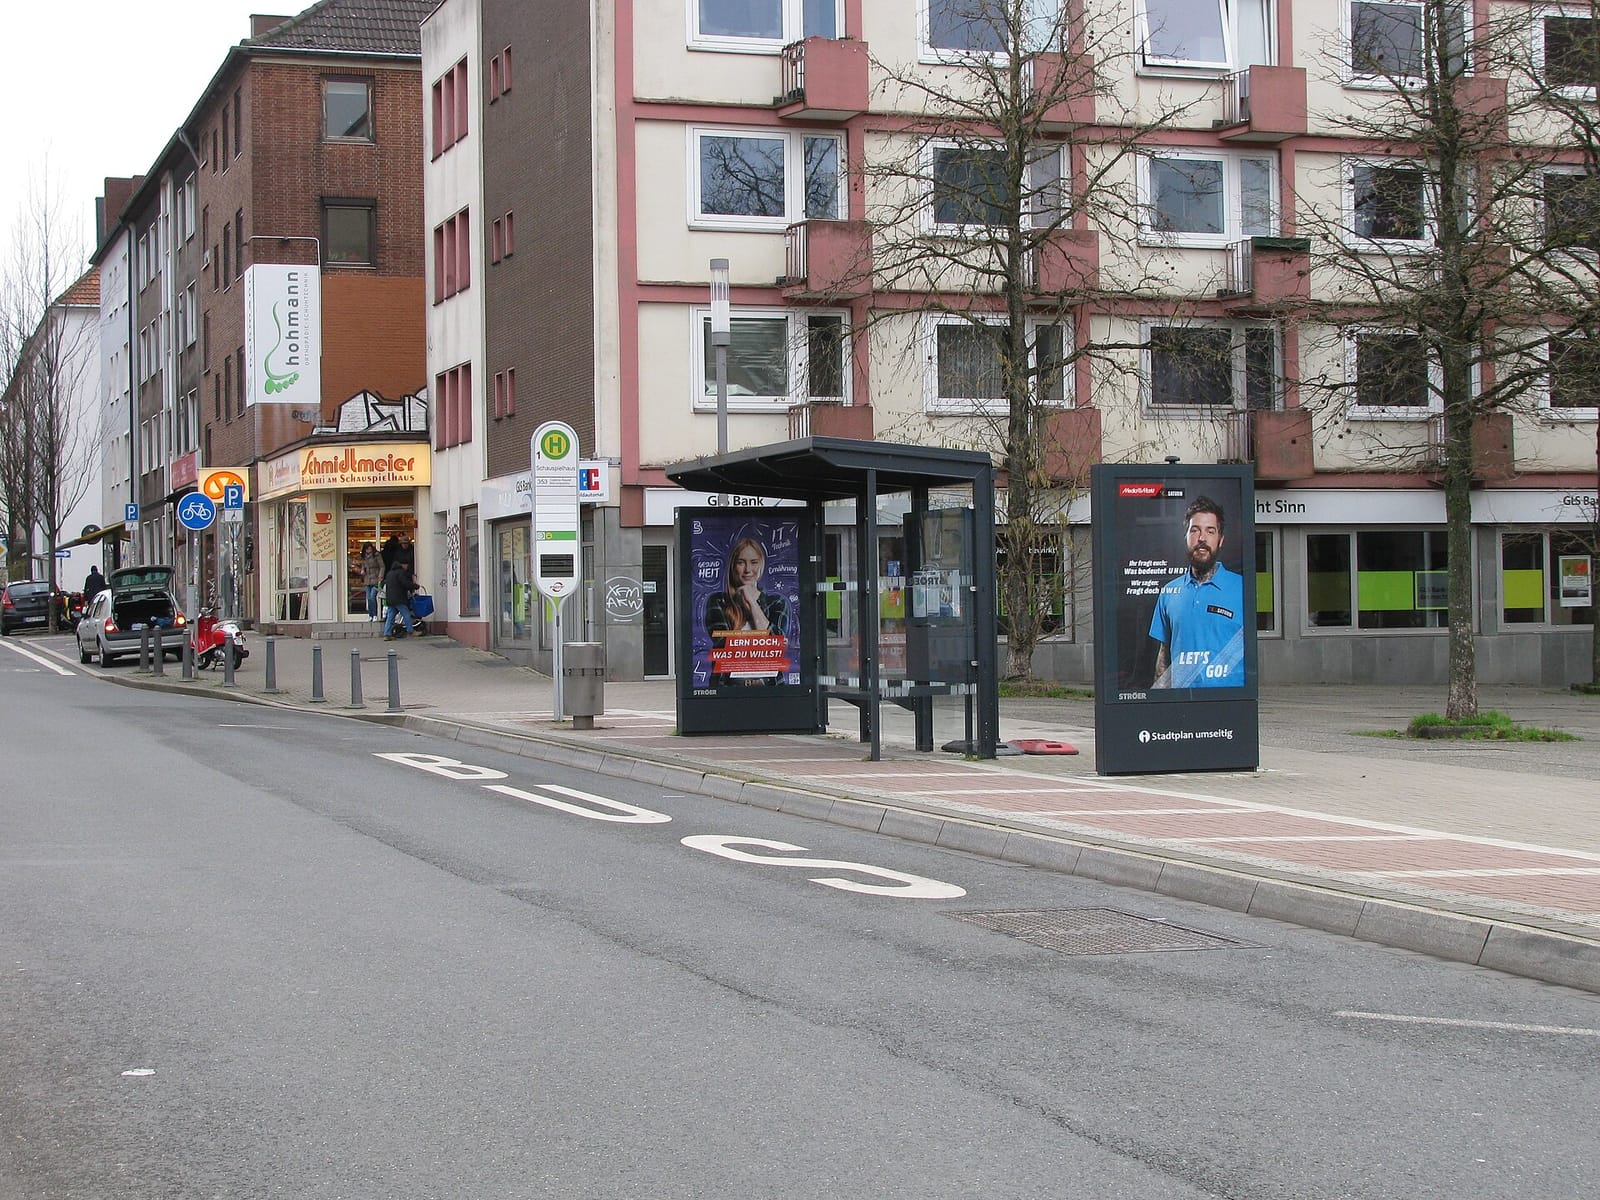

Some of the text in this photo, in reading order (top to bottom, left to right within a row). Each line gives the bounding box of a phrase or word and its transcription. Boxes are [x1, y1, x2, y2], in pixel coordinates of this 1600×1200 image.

[286, 272, 300, 366] hohmann
[302, 448, 415, 475] Schmidtmeier
[733, 495, 764, 506] Bank
[1563, 496, 1598, 506] GLS Ba
[1256, 500, 1306, 513] ht Sinn
[772, 527, 784, 542] IT
[768, 564, 798, 574] Ernährung
[1139, 560, 1152, 568] fragt
[698, 568, 720, 578] HEIT
[1126, 588, 1143, 596] Fragt
[752, 638, 780, 647] DOCH,
[713, 651, 732, 659] WAS
[750, 650, 782, 658] WILLST!
[1179, 651, 1210, 665] LET'S
[1206, 664, 1229, 678] GO!
[1118, 692, 1147, 700] STRÖER
[1152, 728, 1234, 742] Stadtplan umseitig
[371, 752, 967, 899] BUS
